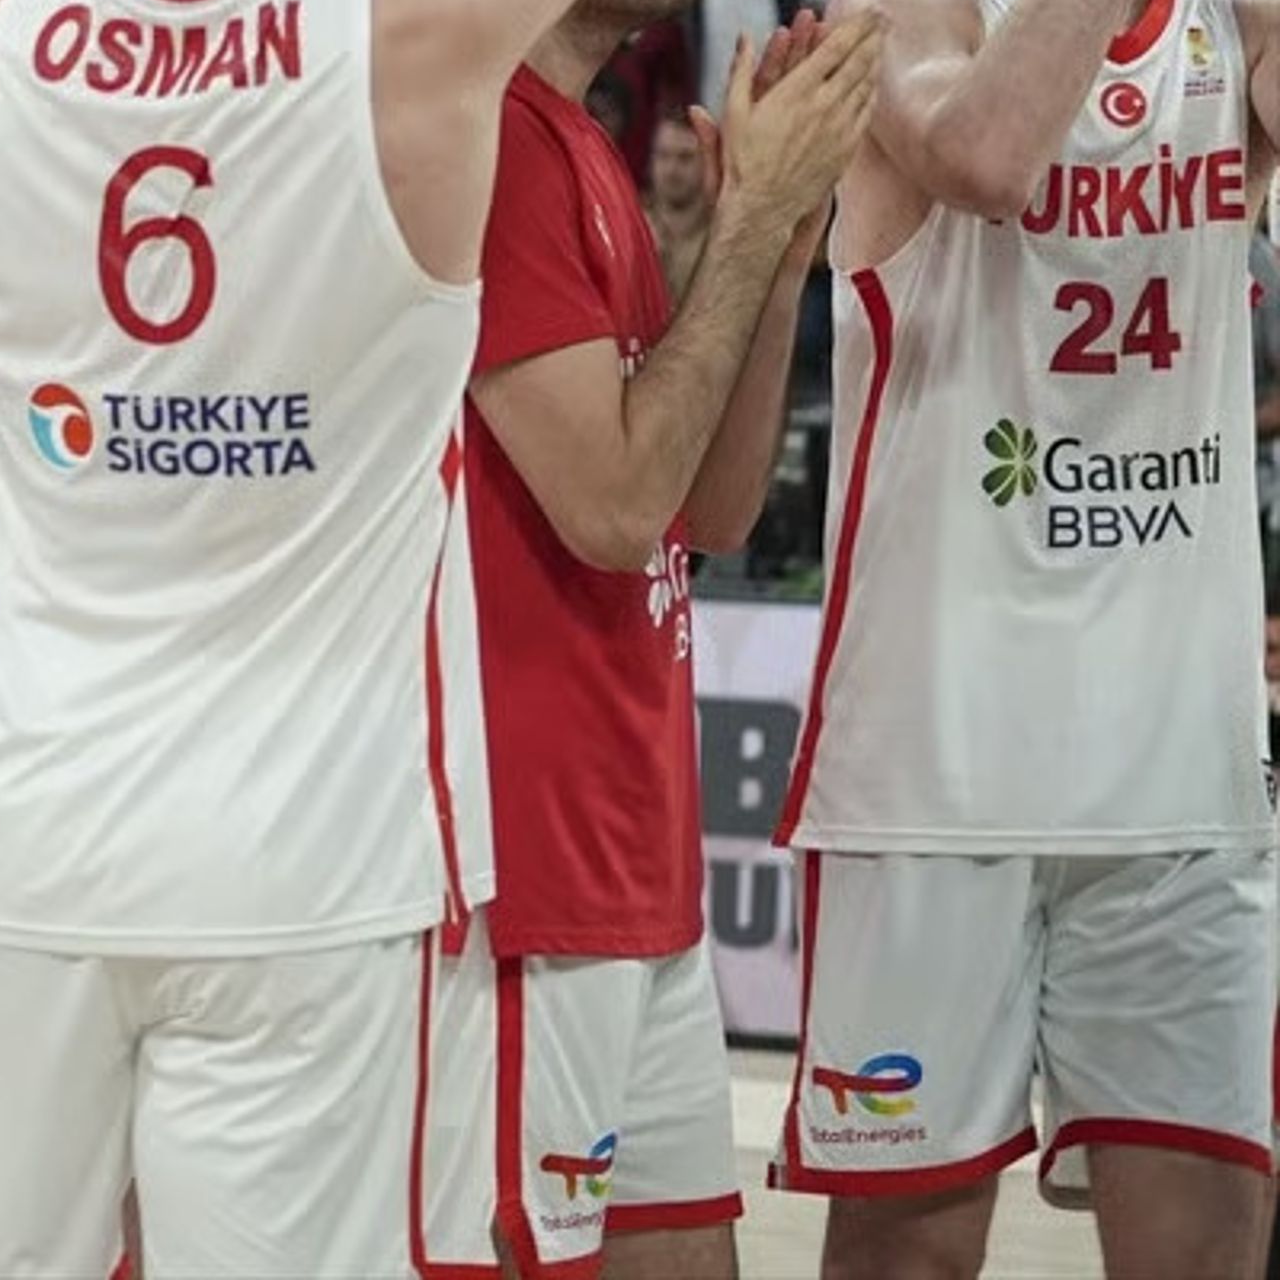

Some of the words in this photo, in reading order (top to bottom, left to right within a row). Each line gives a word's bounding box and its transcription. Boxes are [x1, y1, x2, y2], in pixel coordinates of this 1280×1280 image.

[34, 0, 301, 97] OSMAN
[98, 145, 216, 345] 6
[1049, 276, 1182, 375] 24
[103, 393, 310, 432] TÜRKİYE
[106, 436, 316, 477] SİGORTA
[1043, 432, 1220, 493] Garanti
[1047, 499, 1192, 548] BBVA
